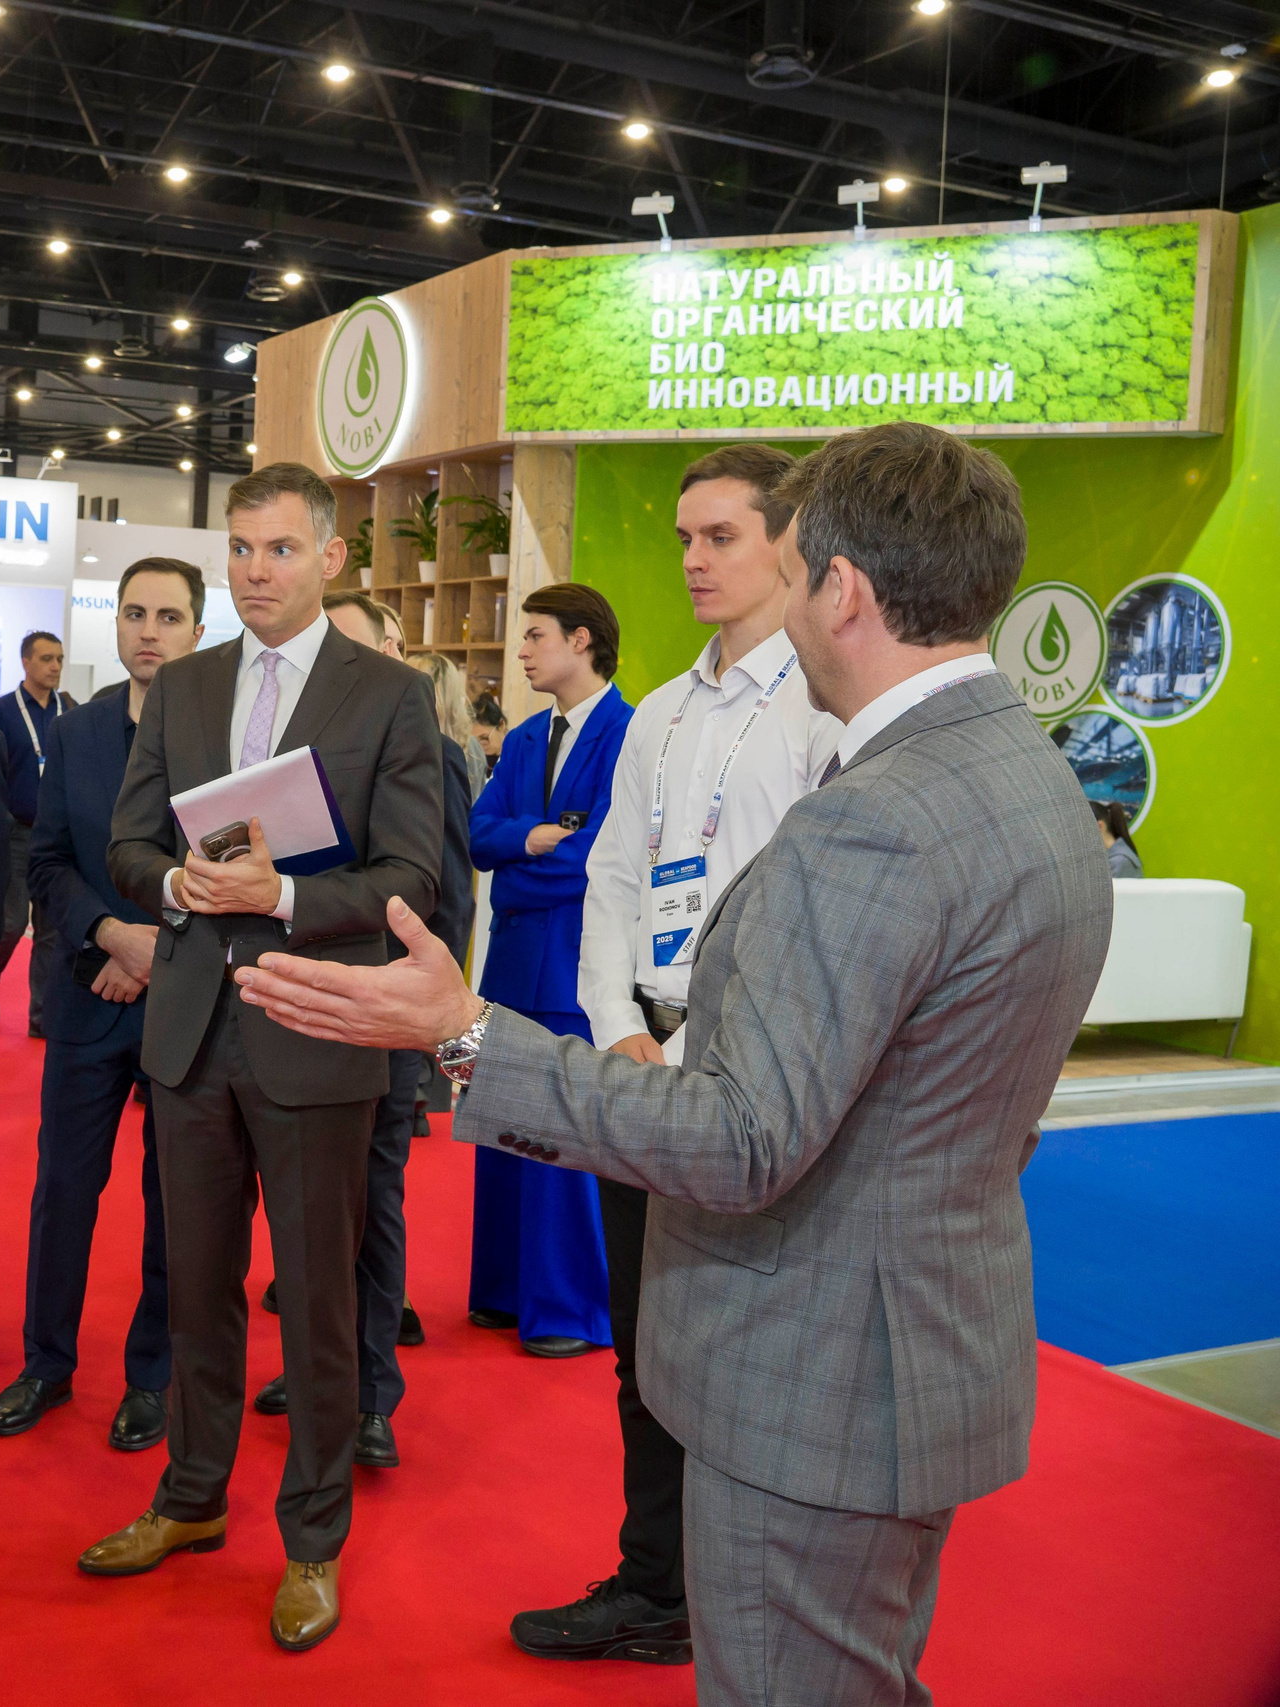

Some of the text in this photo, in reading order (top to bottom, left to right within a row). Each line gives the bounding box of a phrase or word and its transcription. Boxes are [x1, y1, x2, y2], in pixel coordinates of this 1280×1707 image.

[652, 251, 955, 303] НАТУРАЛЬНЫЙ
[651, 288, 964, 339] ОРГАНИЧЕСКИЙ
[649, 341, 726, 375] БИО
[648, 362, 1014, 412] ИННОВАЦИОННЫЙ
[336, 416, 384, 454] NOBI
[1017, 676, 1076, 704] NOBI
[656, 934, 674, 944] 2025
[682, 936, 696, 953] STAFF
